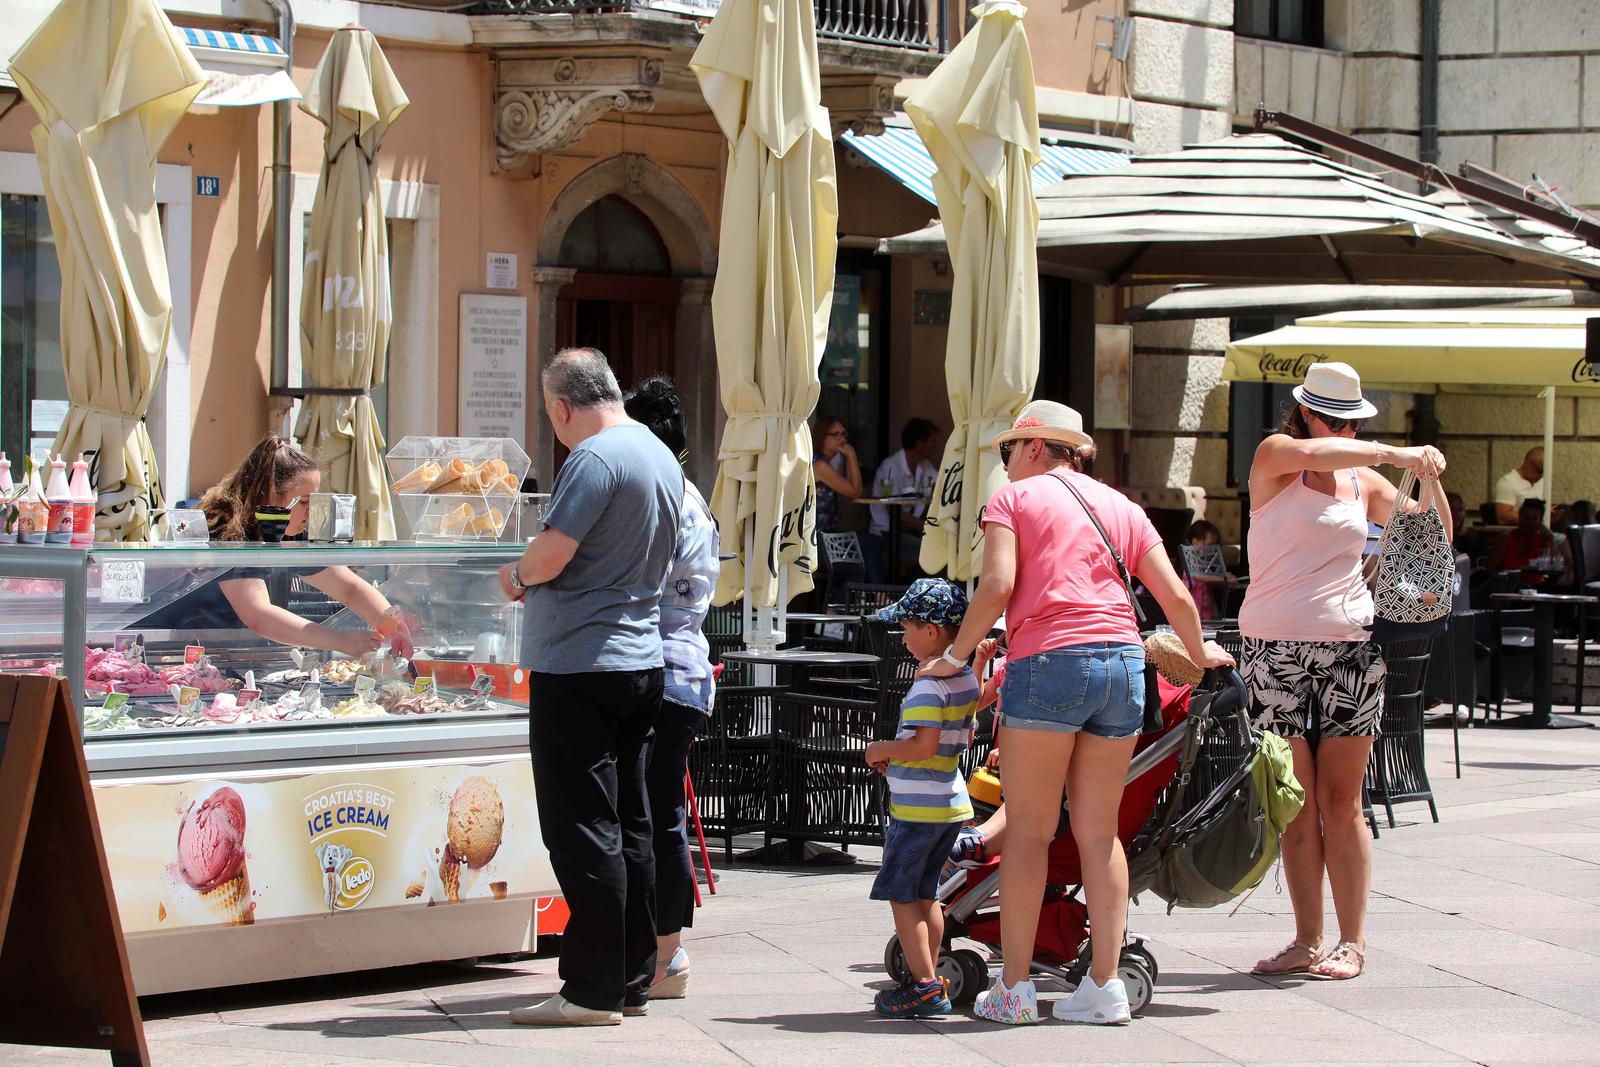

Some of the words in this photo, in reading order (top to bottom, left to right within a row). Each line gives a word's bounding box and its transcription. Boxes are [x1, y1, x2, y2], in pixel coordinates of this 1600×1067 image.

[304, 788, 363, 816] CROATIA'S
[365, 791, 394, 810] BEST
[307, 811, 333, 836] ICE
[336, 806, 390, 830] CREAM
